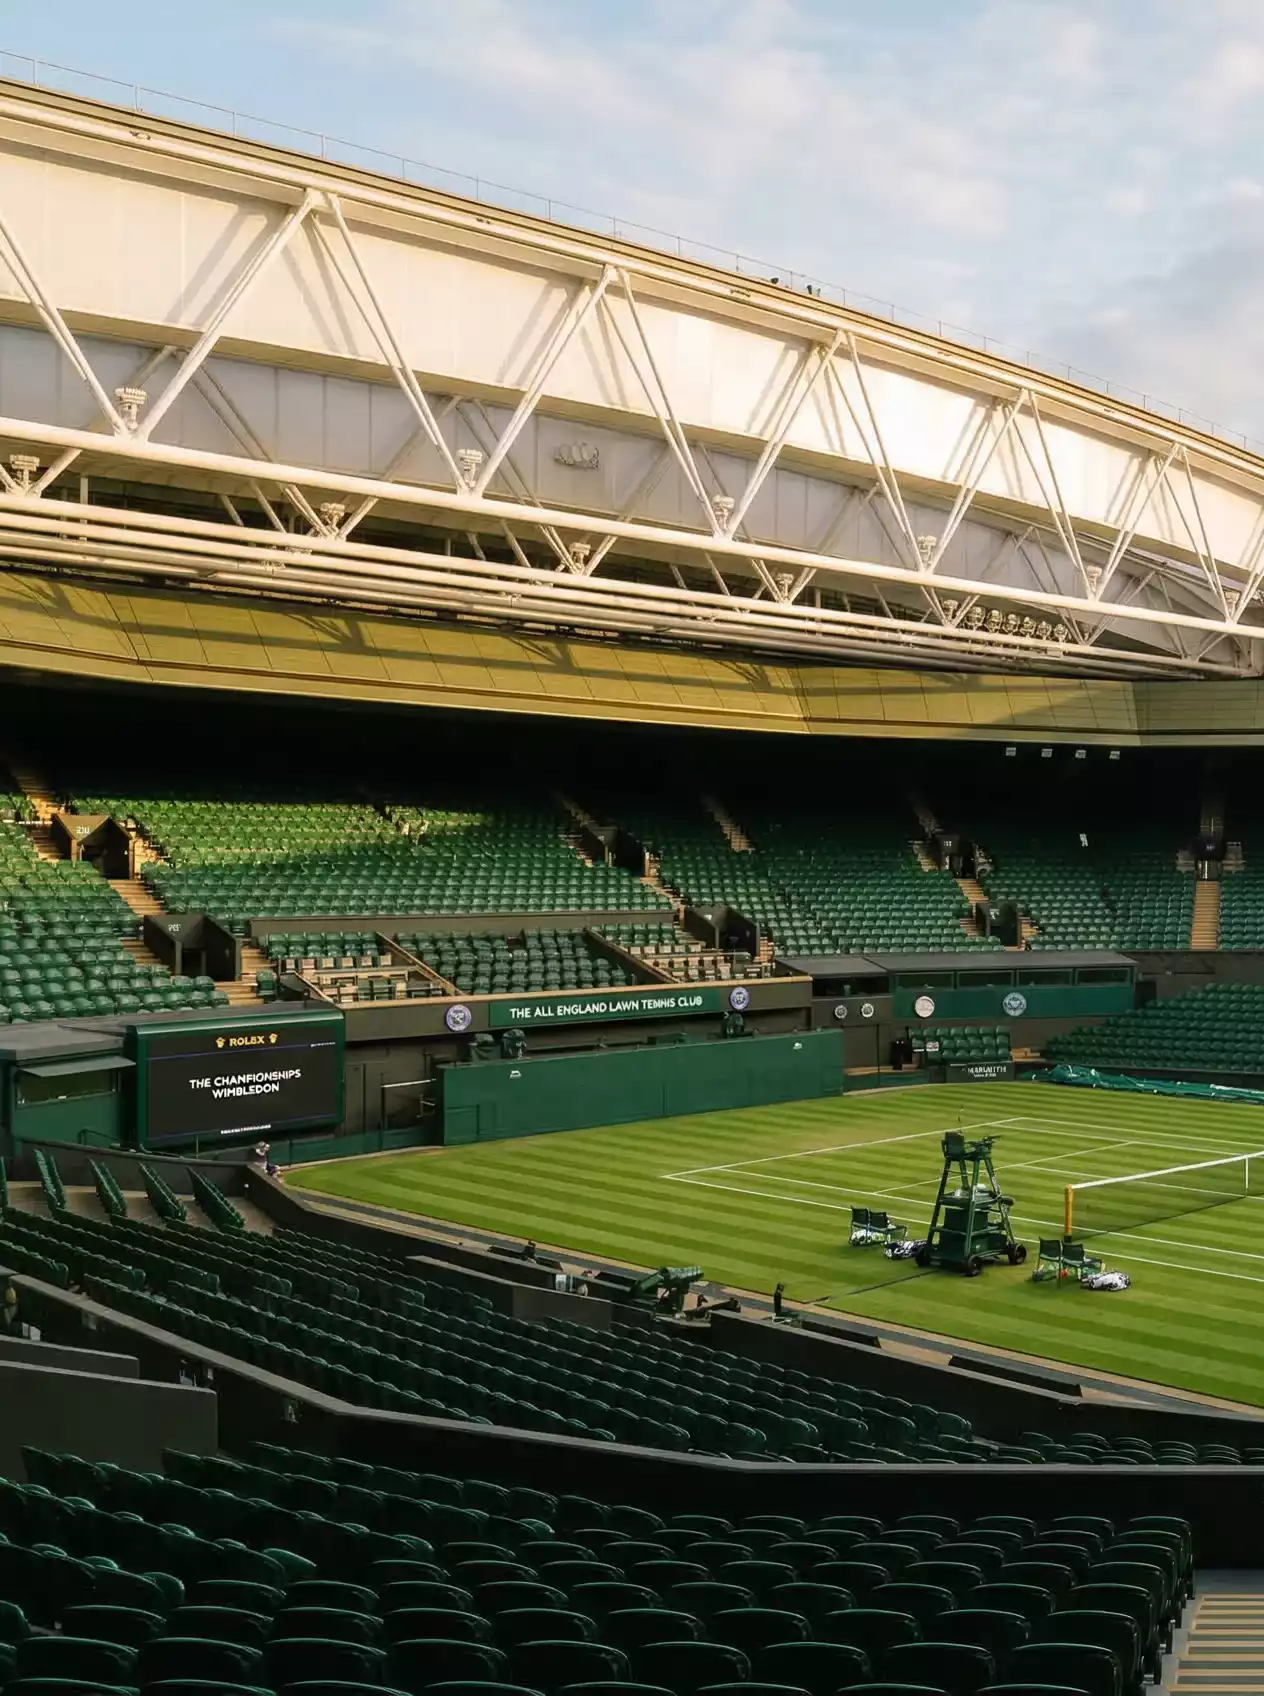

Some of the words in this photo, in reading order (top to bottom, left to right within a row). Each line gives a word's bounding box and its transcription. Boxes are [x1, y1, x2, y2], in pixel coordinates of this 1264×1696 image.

[510, 1008, 532, 1019] THE
[534, 1006, 555, 1017] ALL
[557, 1003, 607, 1016] ENGLAND
[609, 1000, 639, 1012] LAWN
[678, 996, 703, 1008] CLUB
[229, 1036, 265, 1047] ROLEX
[189, 1079, 211, 1089] THE
[212, 1082, 280, 1099] WIMBLEDON
